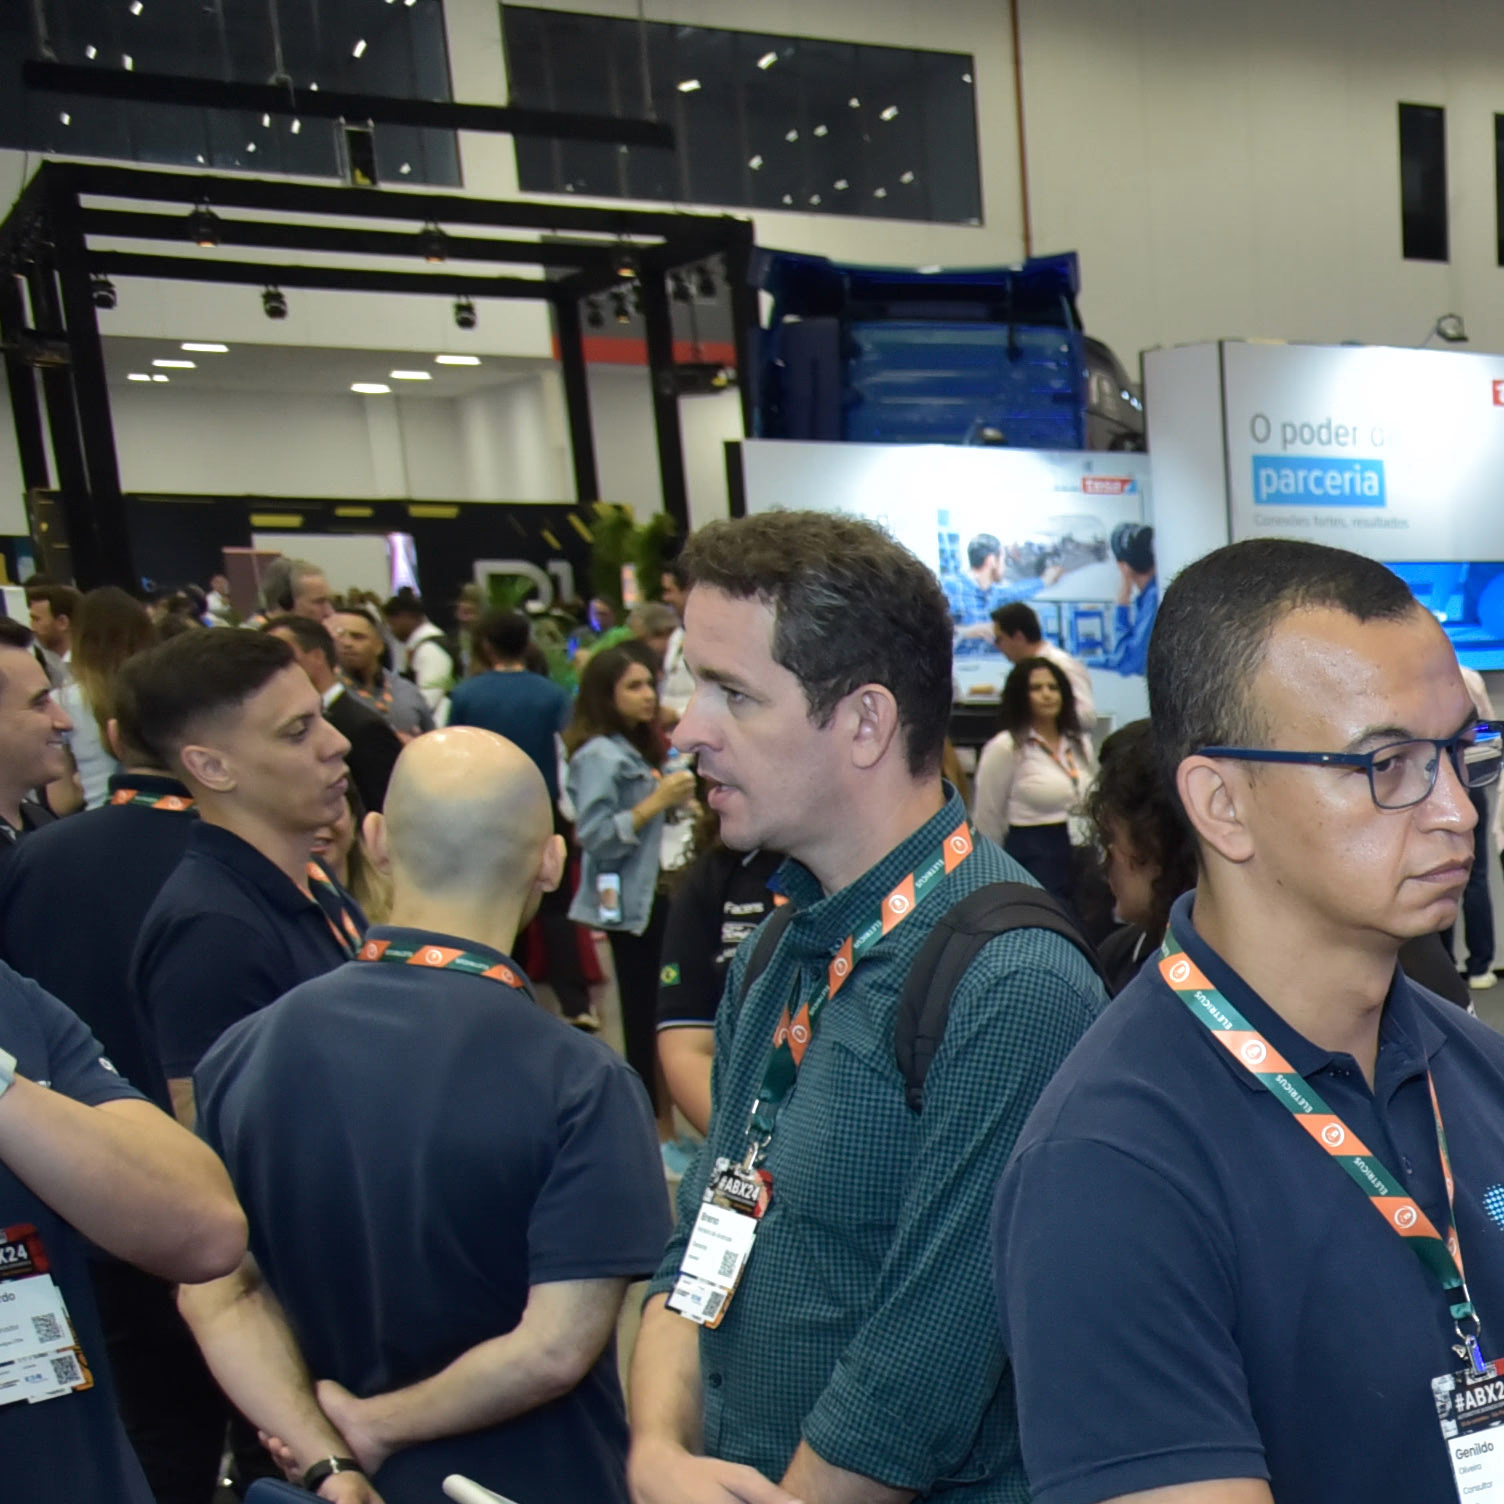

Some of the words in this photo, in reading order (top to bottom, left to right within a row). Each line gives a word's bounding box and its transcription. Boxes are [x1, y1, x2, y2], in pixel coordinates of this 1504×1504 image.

[1250, 413, 1271, 444] O
[1281, 418, 1357, 449] poder
[1259, 464, 1379, 499] parceria
[1194, 991, 1233, 1030] ELETRICUS
[1275, 1074, 1313, 1114] ELETRICUS
[718, 1176, 760, 1201] #ABX24
[1353, 1157, 1388, 1196] ELETRICUS
[1455, 1442, 1494, 1460] Genildo
[1463, 1482, 1493, 1495] Consultor
